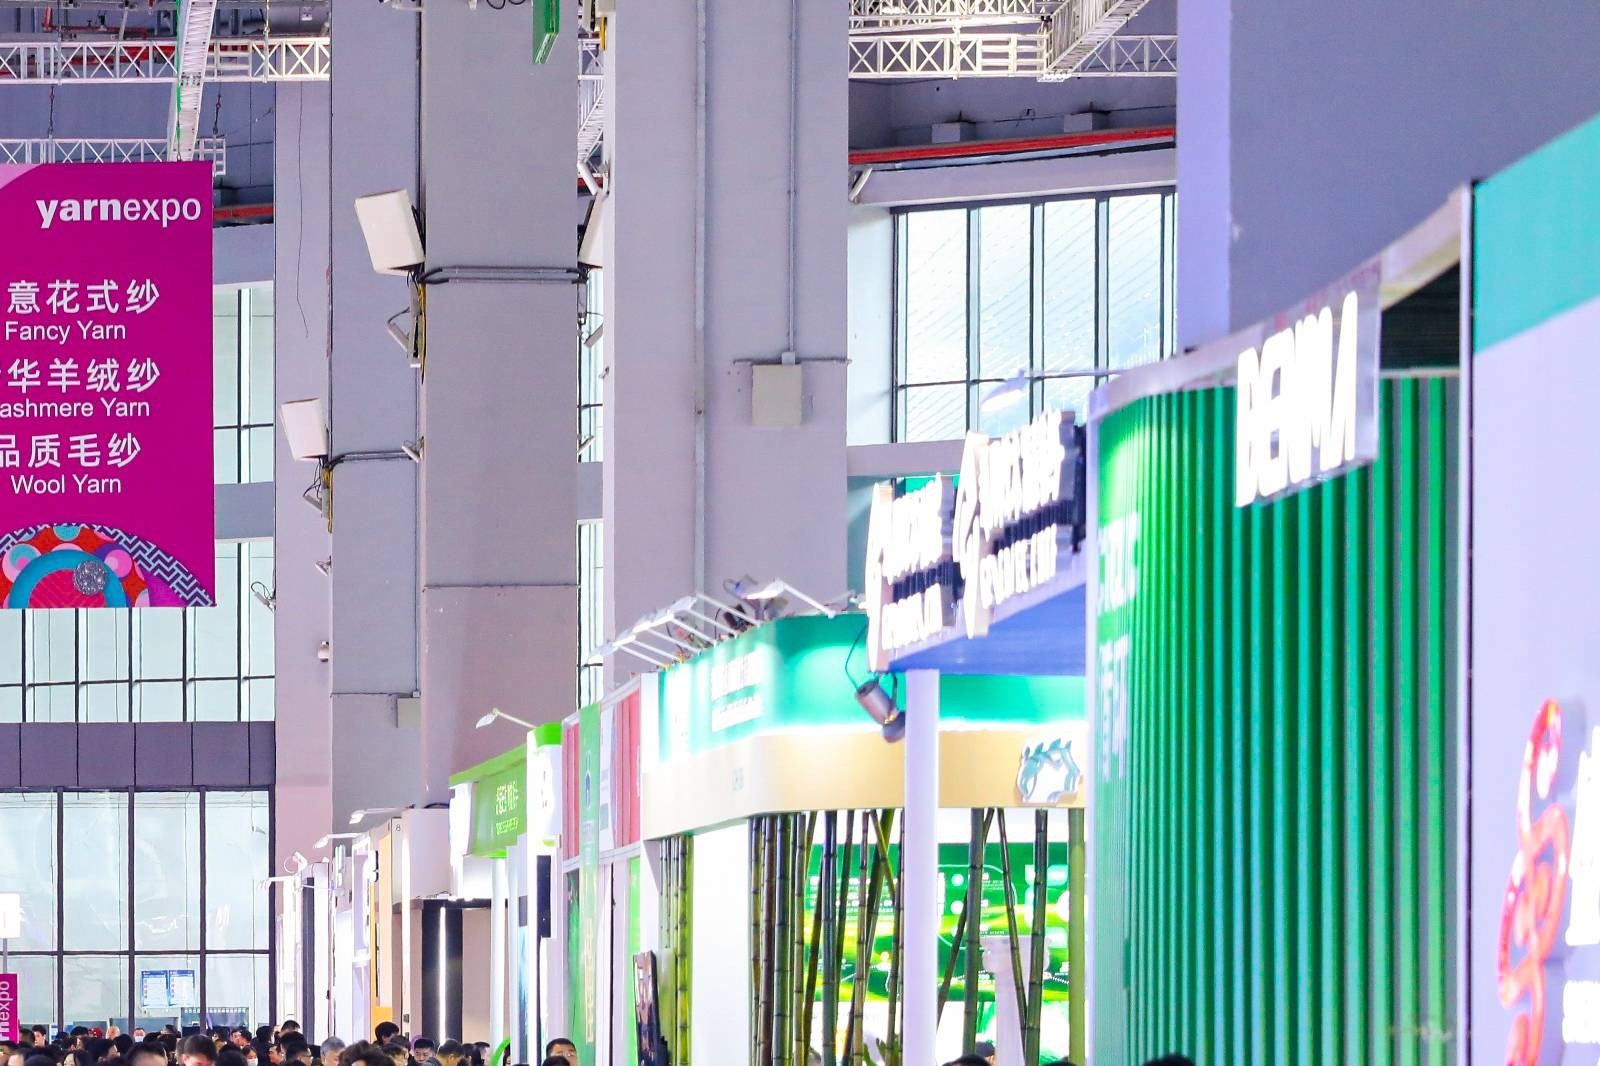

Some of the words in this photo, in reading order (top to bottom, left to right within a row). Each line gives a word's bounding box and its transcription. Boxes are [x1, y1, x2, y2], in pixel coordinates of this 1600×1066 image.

[36, 197, 201, 228] yarnexpo
[5, 321, 70, 344] Fancy
[77, 320, 126, 340] Yarn
[100, 397, 150, 416] Yarn
[10, 475, 65, 494] Wool
[72, 474, 121, 493] Yarn
